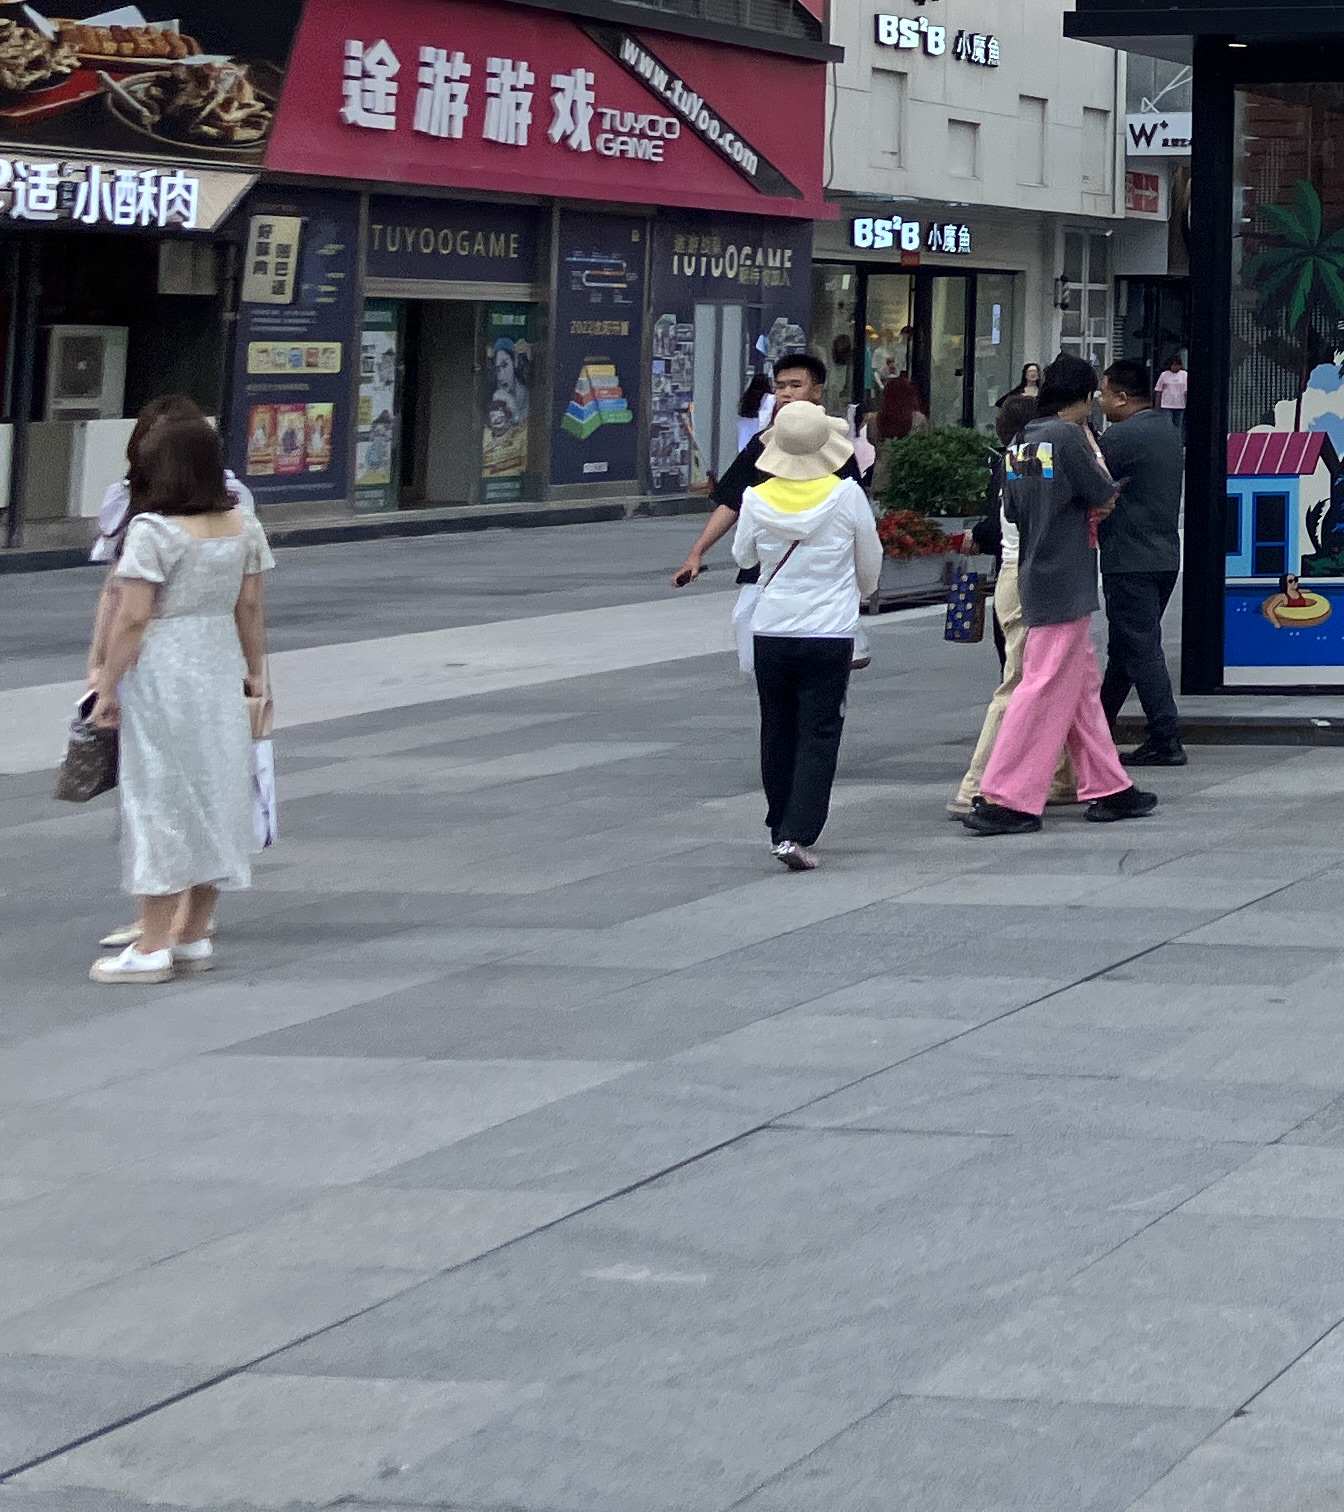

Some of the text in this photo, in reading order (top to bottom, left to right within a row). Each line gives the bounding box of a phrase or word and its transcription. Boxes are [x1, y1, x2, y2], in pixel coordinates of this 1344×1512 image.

[339, 39, 596, 152] 途游游戏
[617, 35, 760, 177] www.tuyoo.com
[597, 107, 681, 140] TUYOO
[596, 133, 665, 163] GAME
[371, 224, 519, 259] TUYOOGAME
